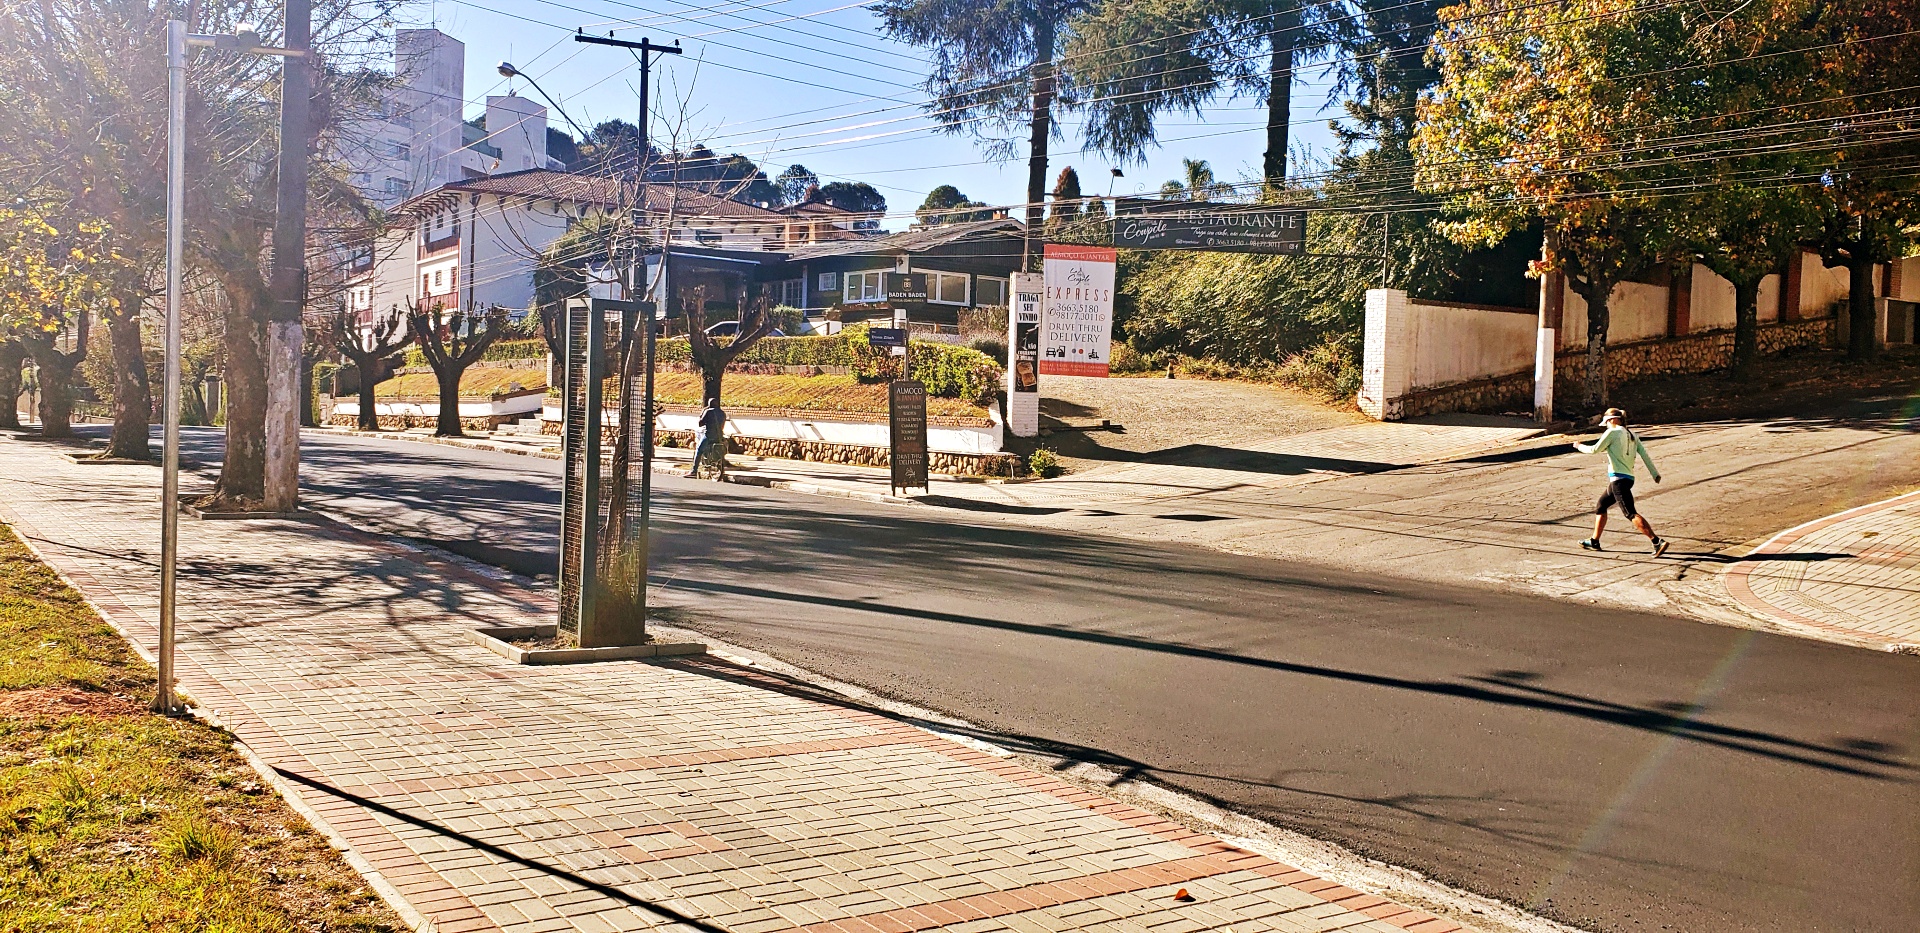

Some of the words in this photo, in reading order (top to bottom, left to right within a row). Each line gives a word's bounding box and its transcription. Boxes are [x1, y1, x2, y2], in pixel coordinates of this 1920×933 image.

[1176, 209, 1297, 229] RESTAURANTE
[1051, 252, 1079, 260] ALMOÇO
[1019, 294, 1039, 303] TRAGA
[1047, 287, 1109, 302] EXPRESS
[1023, 303, 1034, 312] SEU
[1056, 303, 1099, 313] 3663.5180
[1019, 313, 1038, 322] VINHO
[1056, 311, 1098, 321] 98177.3011
[1049, 322, 1075, 332] DRIVE
[1078, 324, 1103, 332] THRU
[1050, 332, 1100, 343] DELIVERY
